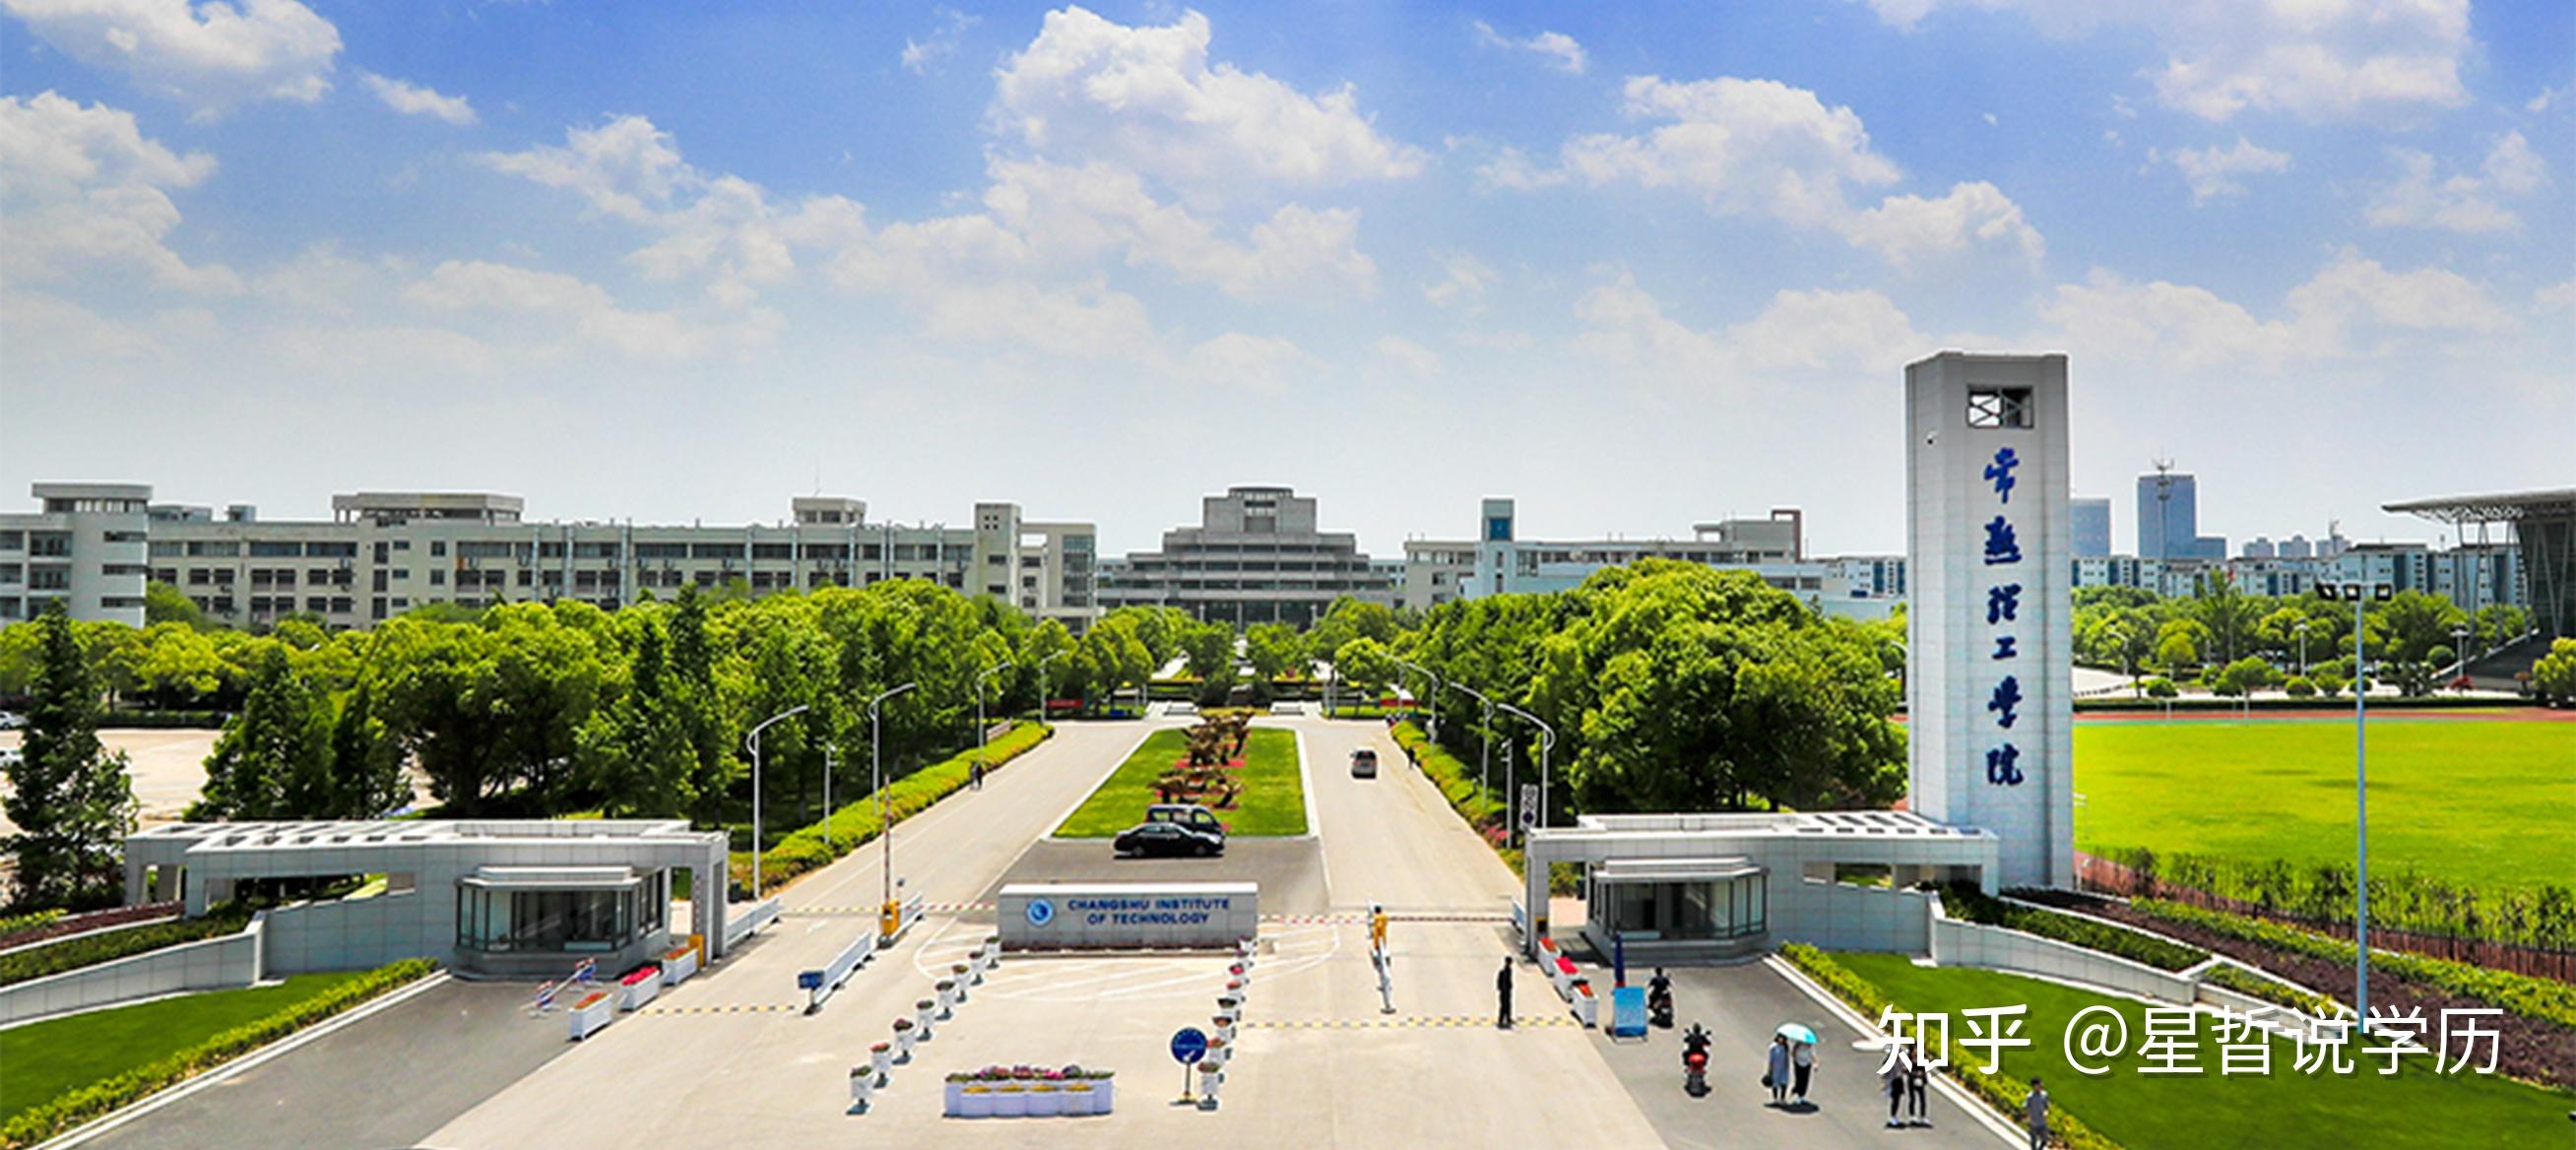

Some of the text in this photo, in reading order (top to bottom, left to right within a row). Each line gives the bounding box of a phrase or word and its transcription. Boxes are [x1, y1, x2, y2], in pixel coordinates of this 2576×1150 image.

[1067, 898, 1230, 912] CHANGSHU INSTITUTE
[1087, 913, 1209, 926] OF TECHNOLOGY
